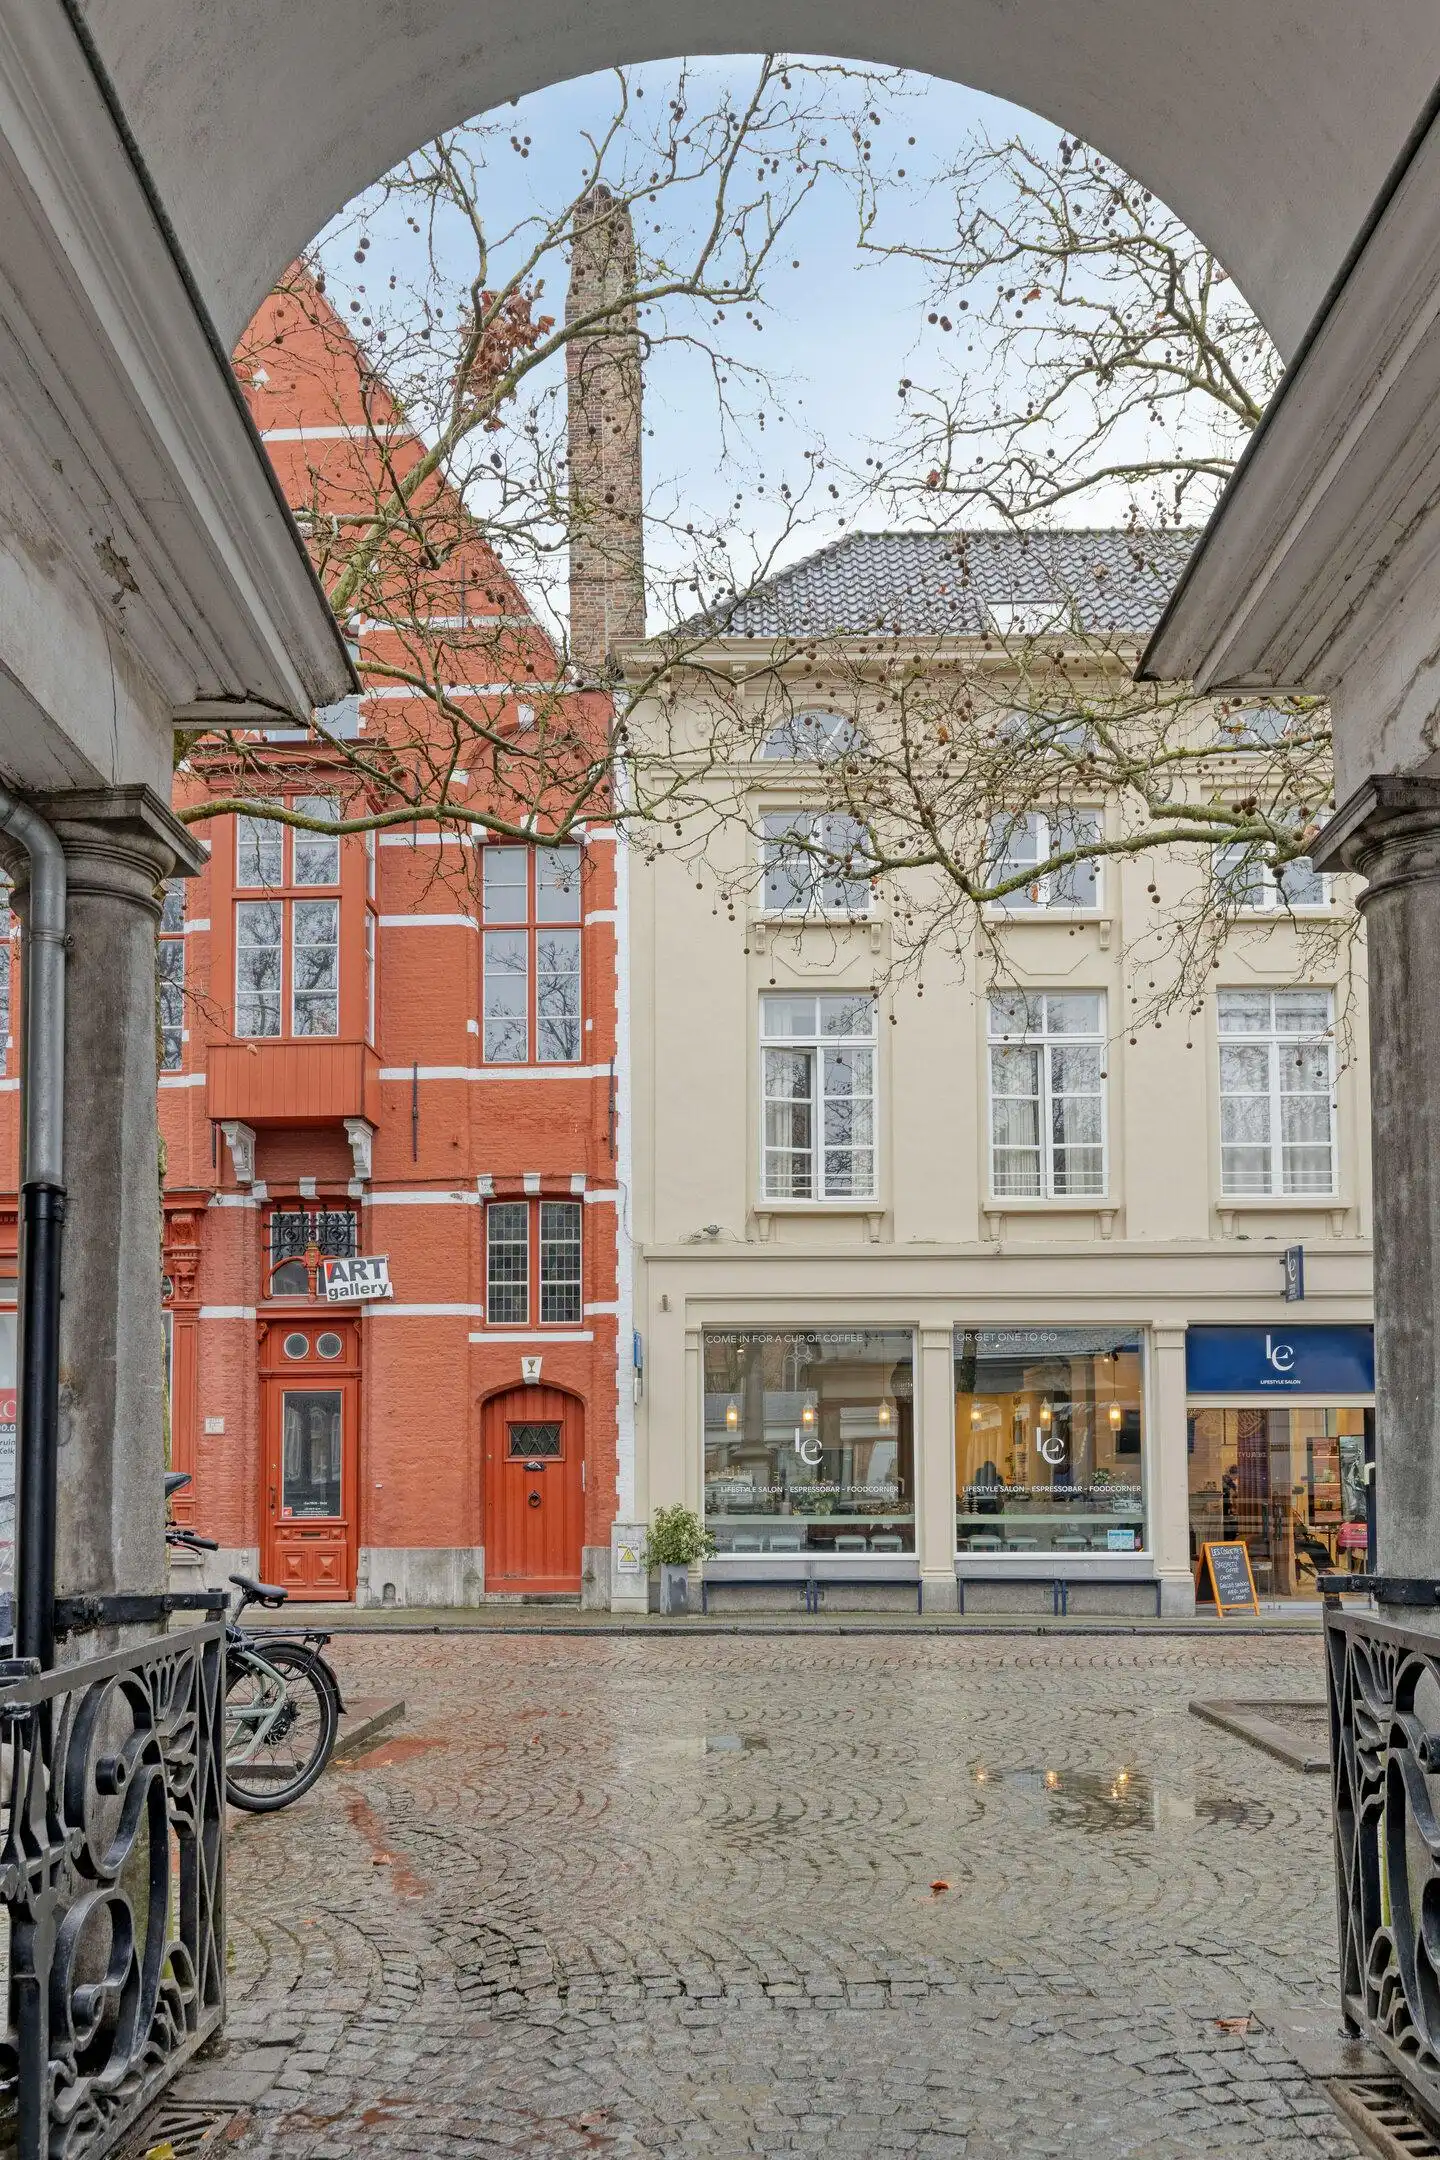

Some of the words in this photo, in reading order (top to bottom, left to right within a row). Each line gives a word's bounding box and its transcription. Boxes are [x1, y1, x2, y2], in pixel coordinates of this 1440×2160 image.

[326, 1258, 386, 1283] ART
[328, 1283, 388, 1300] gallery
[705, 1335, 736, 1344] COME
[739, 1335, 750, 1343] IN
[752, 1334, 773, 1343] FOR
[774, 1334, 782, 1343] A
[783, 1334, 806, 1343] CUP
[807, 1334, 822, 1343] OF
[823, 1334, 863, 1343] COFFEE
[956, 1332, 972, 1341] OR
[974, 1332, 996, 1341] GET
[997, 1332, 1021, 1341] ONE
[1023, 1332, 1038, 1341] TO
[1040, 1332, 1058, 1341] GO
